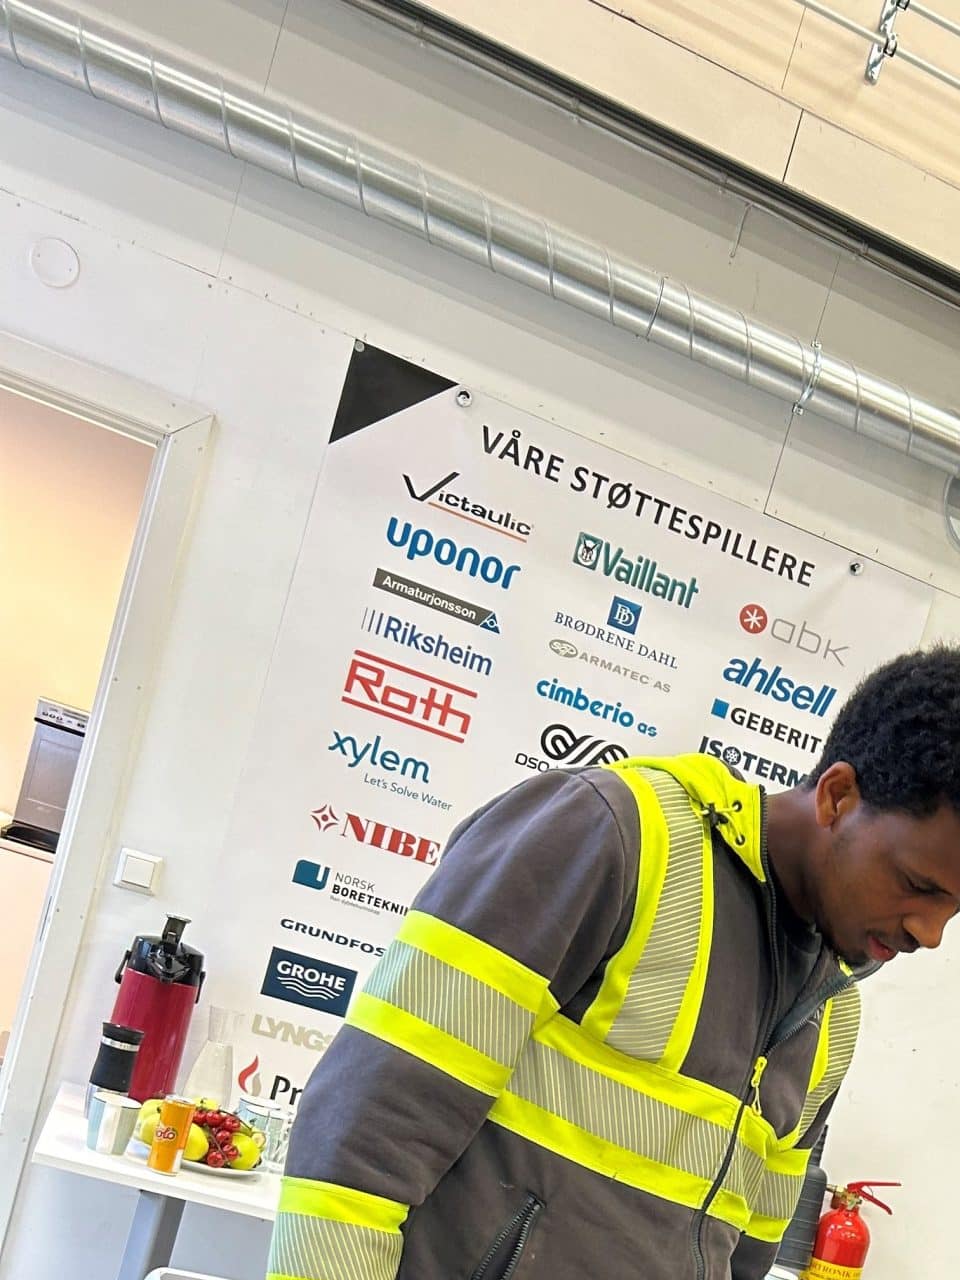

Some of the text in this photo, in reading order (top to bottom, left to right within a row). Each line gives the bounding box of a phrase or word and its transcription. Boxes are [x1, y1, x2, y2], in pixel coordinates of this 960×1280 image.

[402, 471, 532, 536] Victaulic
[482, 425, 815, 587] VÅRE STØTTESPILLERE
[386, 517, 521, 589] uponor
[602, 541, 699, 608] Vaillant
[382, 575, 477, 621] Armaturjonsson
[383, 615, 493, 676] Riksheim
[554, 611, 678, 669] BRØDRENE DAHL
[770, 618, 850, 667] abk
[344, 658, 471, 735] Roth
[578, 652, 671, 693] ARMATEC AS
[722, 656, 837, 718] ahlsell
[536, 677, 658, 738] cimberio as
[730, 706, 823, 754] GEBERIT
[328, 730, 430, 784] xylem
[364, 773, 453, 811] Let's Solve Water
[340, 812, 441, 867] NIBE
[335, 872, 376, 893] NORSK
[280, 918, 387, 958] GRUNDFOS
[276, 960, 346, 991] GROHE
